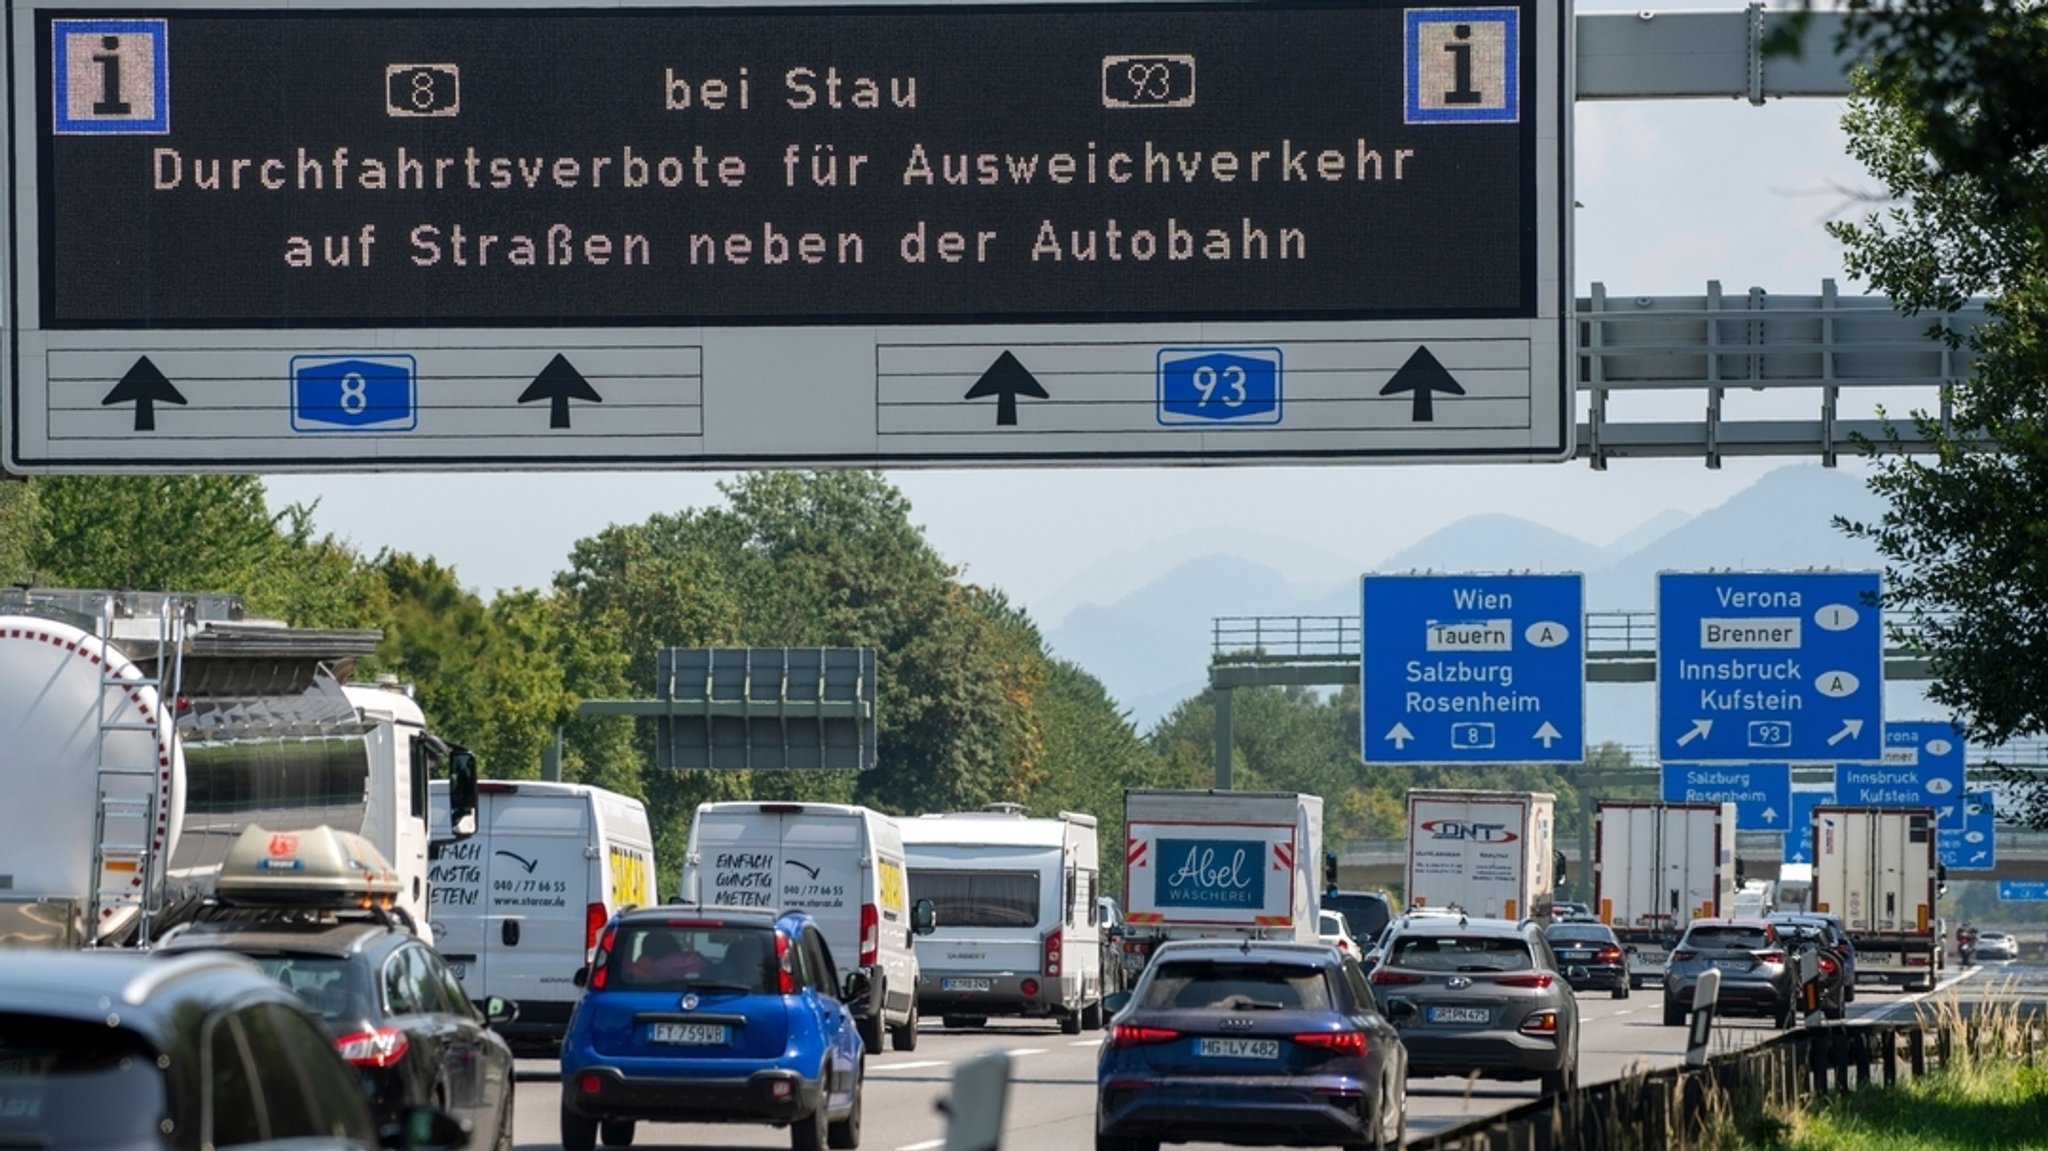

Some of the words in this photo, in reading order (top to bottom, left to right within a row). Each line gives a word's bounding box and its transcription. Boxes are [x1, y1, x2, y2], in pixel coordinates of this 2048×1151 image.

[413, 72, 433, 108] 8
[666, 69, 749, 110] bei
[786, 65, 917, 109] Stau
[1128, 63, 1170, 100] 93
[154, 146, 746, 190] Durchfahrtsverbote
[784, 144, 868, 187] für
[904, 139, 1414, 186] Ausweichverkehr
[285, 226, 376, 267] auf
[410, 224, 650, 266] Straßen
[690, 222, 864, 265] neben
[900, 222, 996, 263] der
[1032, 219, 1305, 262] Autobahn
[341, 373, 366, 414] 8
[1192, 367, 1247, 408] 93
[1453, 589, 1513, 610] Wien
[1716, 587, 1801, 608] Verona
[1434, 627, 1505, 645] Tauern
[1540, 627, 1554, 643] A
[1707, 625, 1793, 643] Brenner
[1406, 661, 1513, 687] Salzburg
[1679, 659, 1802, 680] Innsbruck
[1830, 676, 1843, 693] A
[1406, 691, 1540, 713] Rosenheim
[1701, 690, 1802, 711] Kufstein
[1468, 728, 1479, 744] 8
[1759, 726, 1781, 743] 93
[1887, 731, 1919, 742] rona
[1885, 753, 1913, 763] nner
[1687, 771, 1750, 788] Salzburg
[1847, 772, 1918, 784] Innsbruck
[1686, 789, 1766, 802] Rosenheim
[1860, 789, 1919, 802] Kufstein
[1168, 845, 1251, 888] Abel
[493, 880, 513, 890] 040
[523, 880, 536, 891] 77
[538, 882, 551, 892] 66
[553, 882, 566, 892] 55
[493, 896, 565, 907] www.starcar.de
[1170, 889, 1252, 902] WÄSCHEREI
[1202, 1040, 1220, 1055] HG
[1229, 1040, 1248, 1055] LY
[1250, 1042, 1277, 1057] 482
